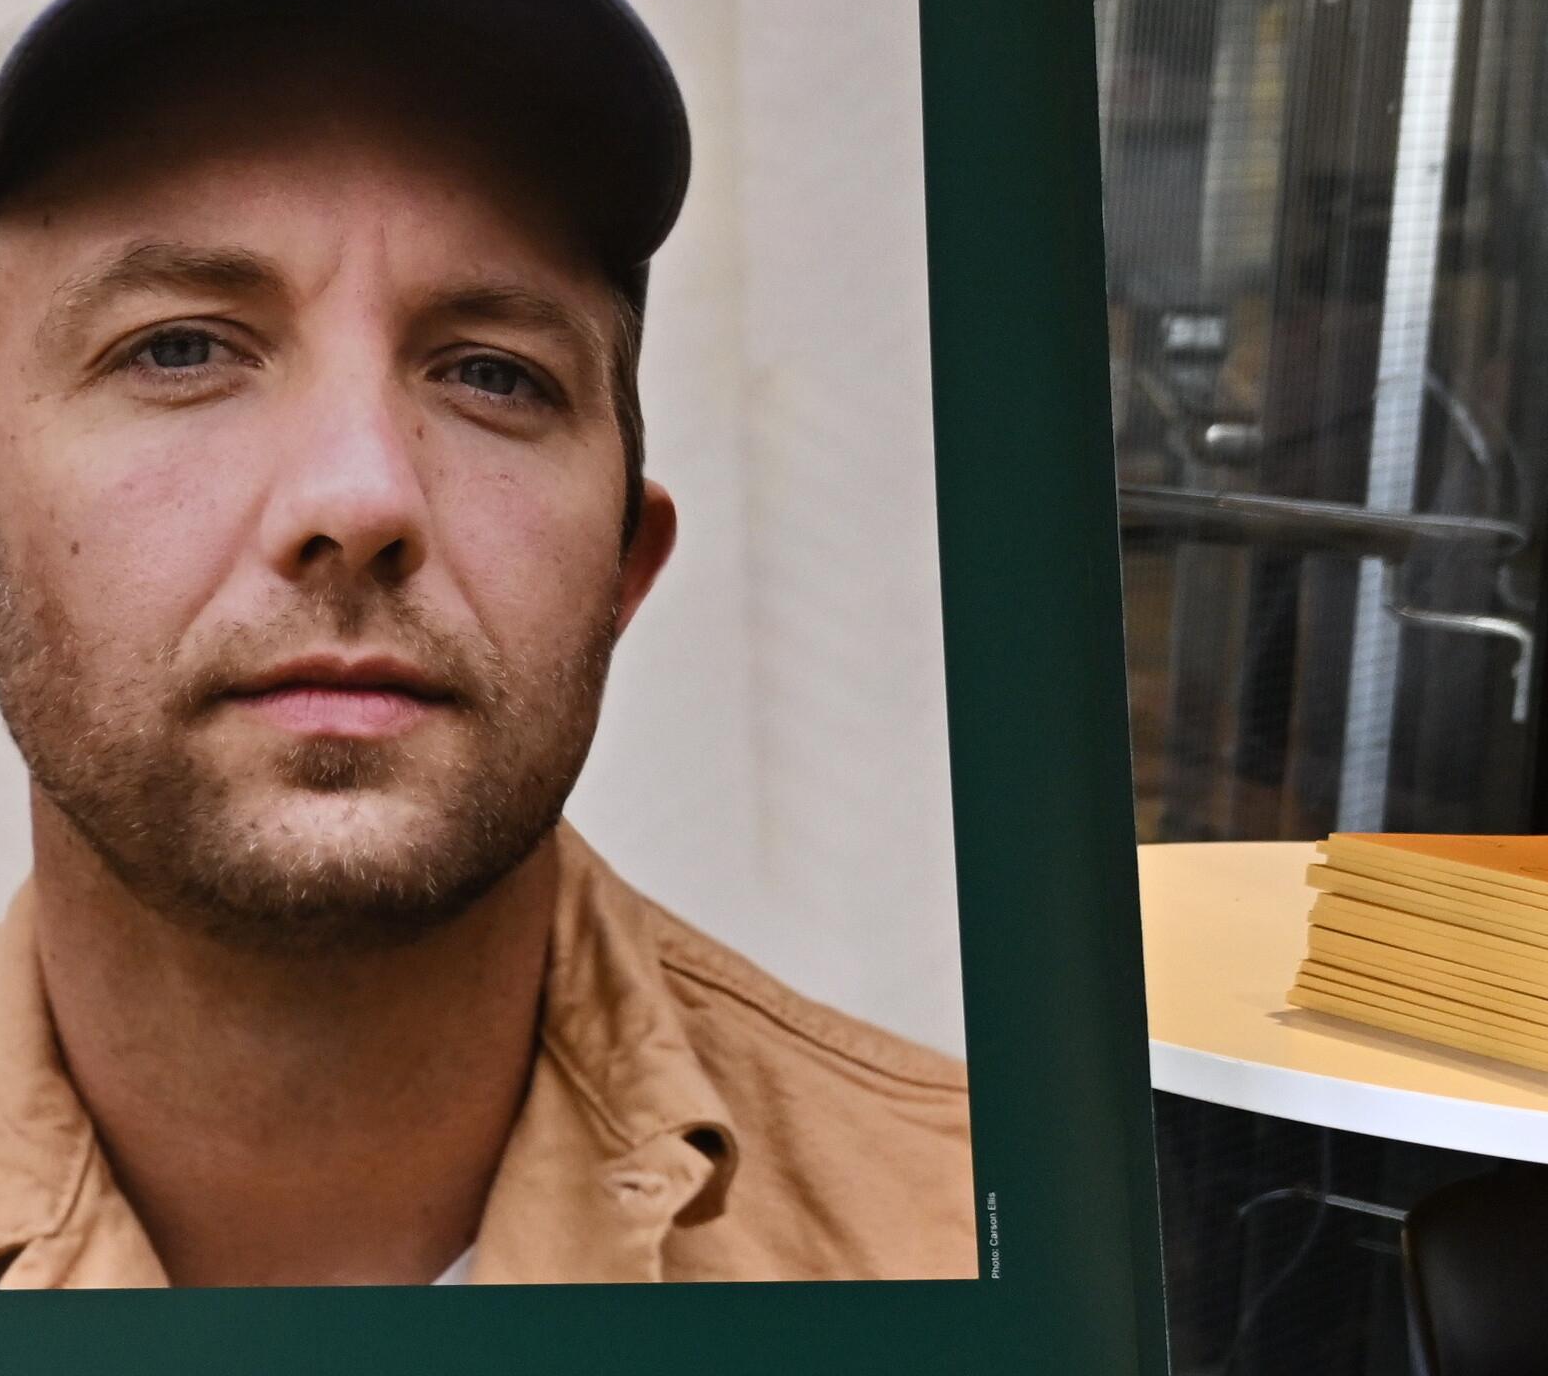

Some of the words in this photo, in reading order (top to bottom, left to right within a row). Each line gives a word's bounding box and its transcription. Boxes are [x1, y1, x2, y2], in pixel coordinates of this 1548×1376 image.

[987, 1192, 996, 1210] Ellis
[989, 1213, 998, 1246] Carson
[991, 1249, 1000, 1279] Photo:
